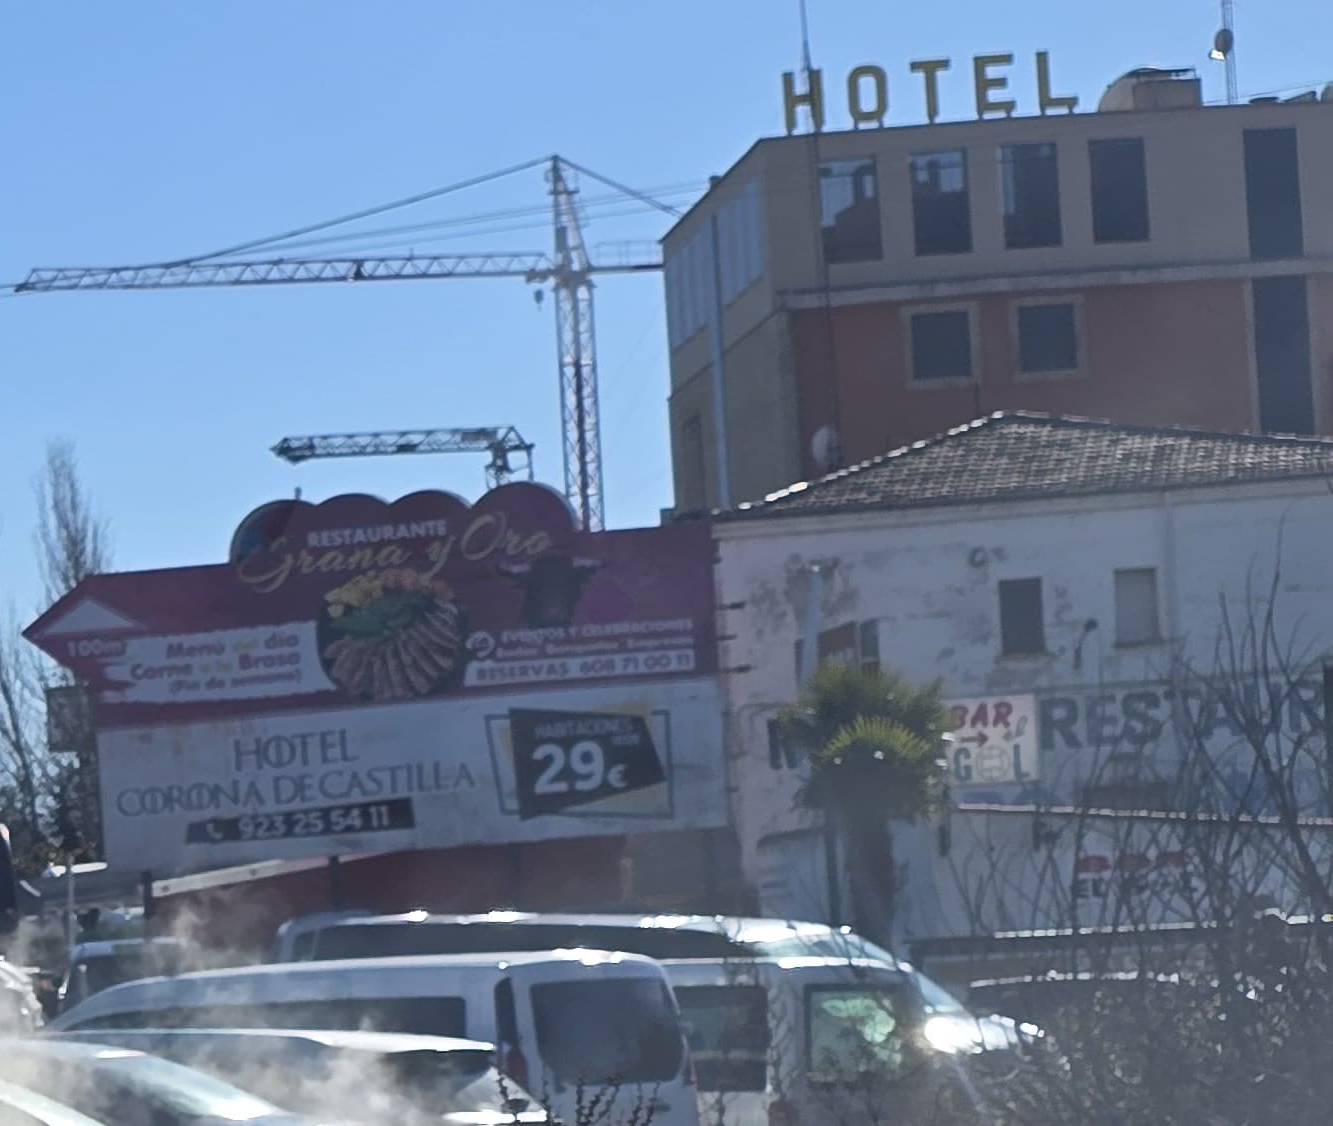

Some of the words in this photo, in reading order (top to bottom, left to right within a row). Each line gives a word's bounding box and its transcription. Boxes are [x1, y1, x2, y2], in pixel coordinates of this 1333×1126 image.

[782, 51, 1080, 134] HOTEL
[237, 537, 412, 593] Grana
[460, 512, 551, 560] Oro
[308, 519, 448, 548] RESTAURANTE
[476, 660, 570, 681] RESERVAS
[948, 701, 1014, 729] BAR
[233, 728, 360, 772] HOTEL
[116, 778, 267, 817] CORONA
[273, 773, 315, 806] DE
[318, 761, 477, 801] CASTILLA
[238, 814, 284, 838] 923
[293, 811, 324, 834] 25
[332, 807, 362, 830] 54
[369, 805, 389, 828] 11
